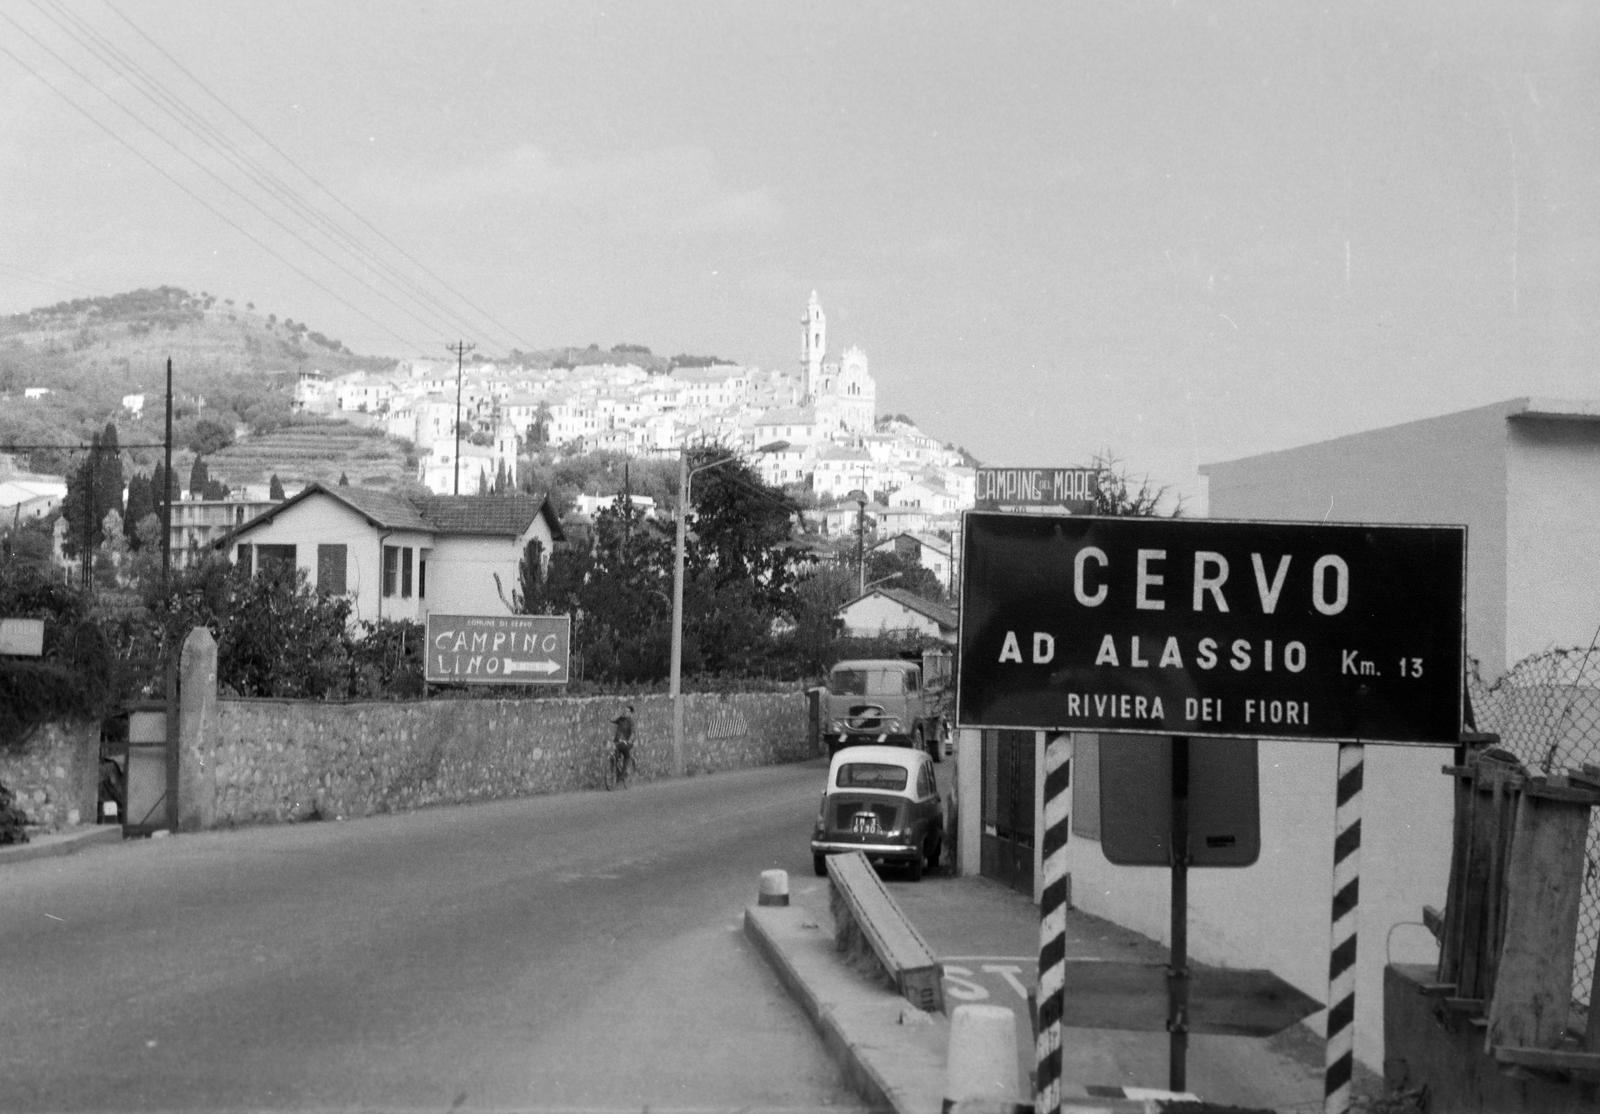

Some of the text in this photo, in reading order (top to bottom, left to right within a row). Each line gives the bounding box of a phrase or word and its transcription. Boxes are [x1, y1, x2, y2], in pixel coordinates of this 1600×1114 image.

[976, 470, 1042, 500] CAMPING
[1053, 470, 1095, 501] MARE
[1073, 546, 1349, 616] CERVO
[435, 630, 557, 653] CAMPING
[998, 631, 1424, 678] AD ALASSIO Km. 13
[438, 655, 499, 674] LINO
[1068, 693, 1309, 725] RIVIERA DEI FIORI
